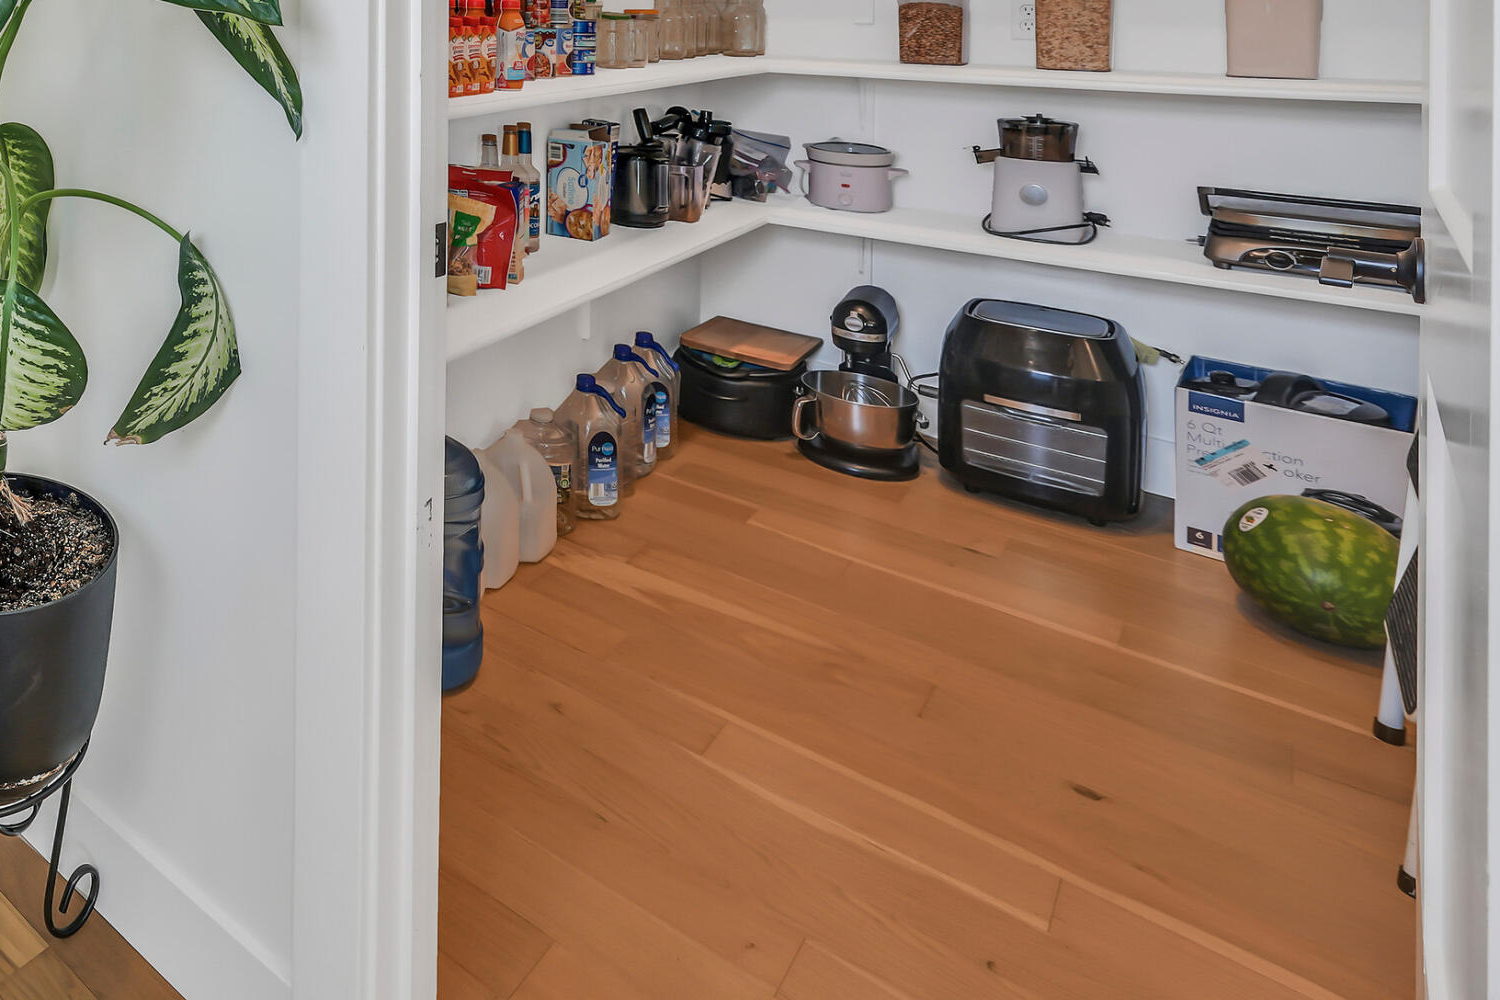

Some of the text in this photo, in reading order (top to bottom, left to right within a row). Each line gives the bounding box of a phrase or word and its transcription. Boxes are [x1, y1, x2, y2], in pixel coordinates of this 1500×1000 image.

[1192, 404, 1241, 419] INSIGNIA
[1186, 419, 1223, 436] 6 Qt
[1195, 531, 1205, 540] 6
